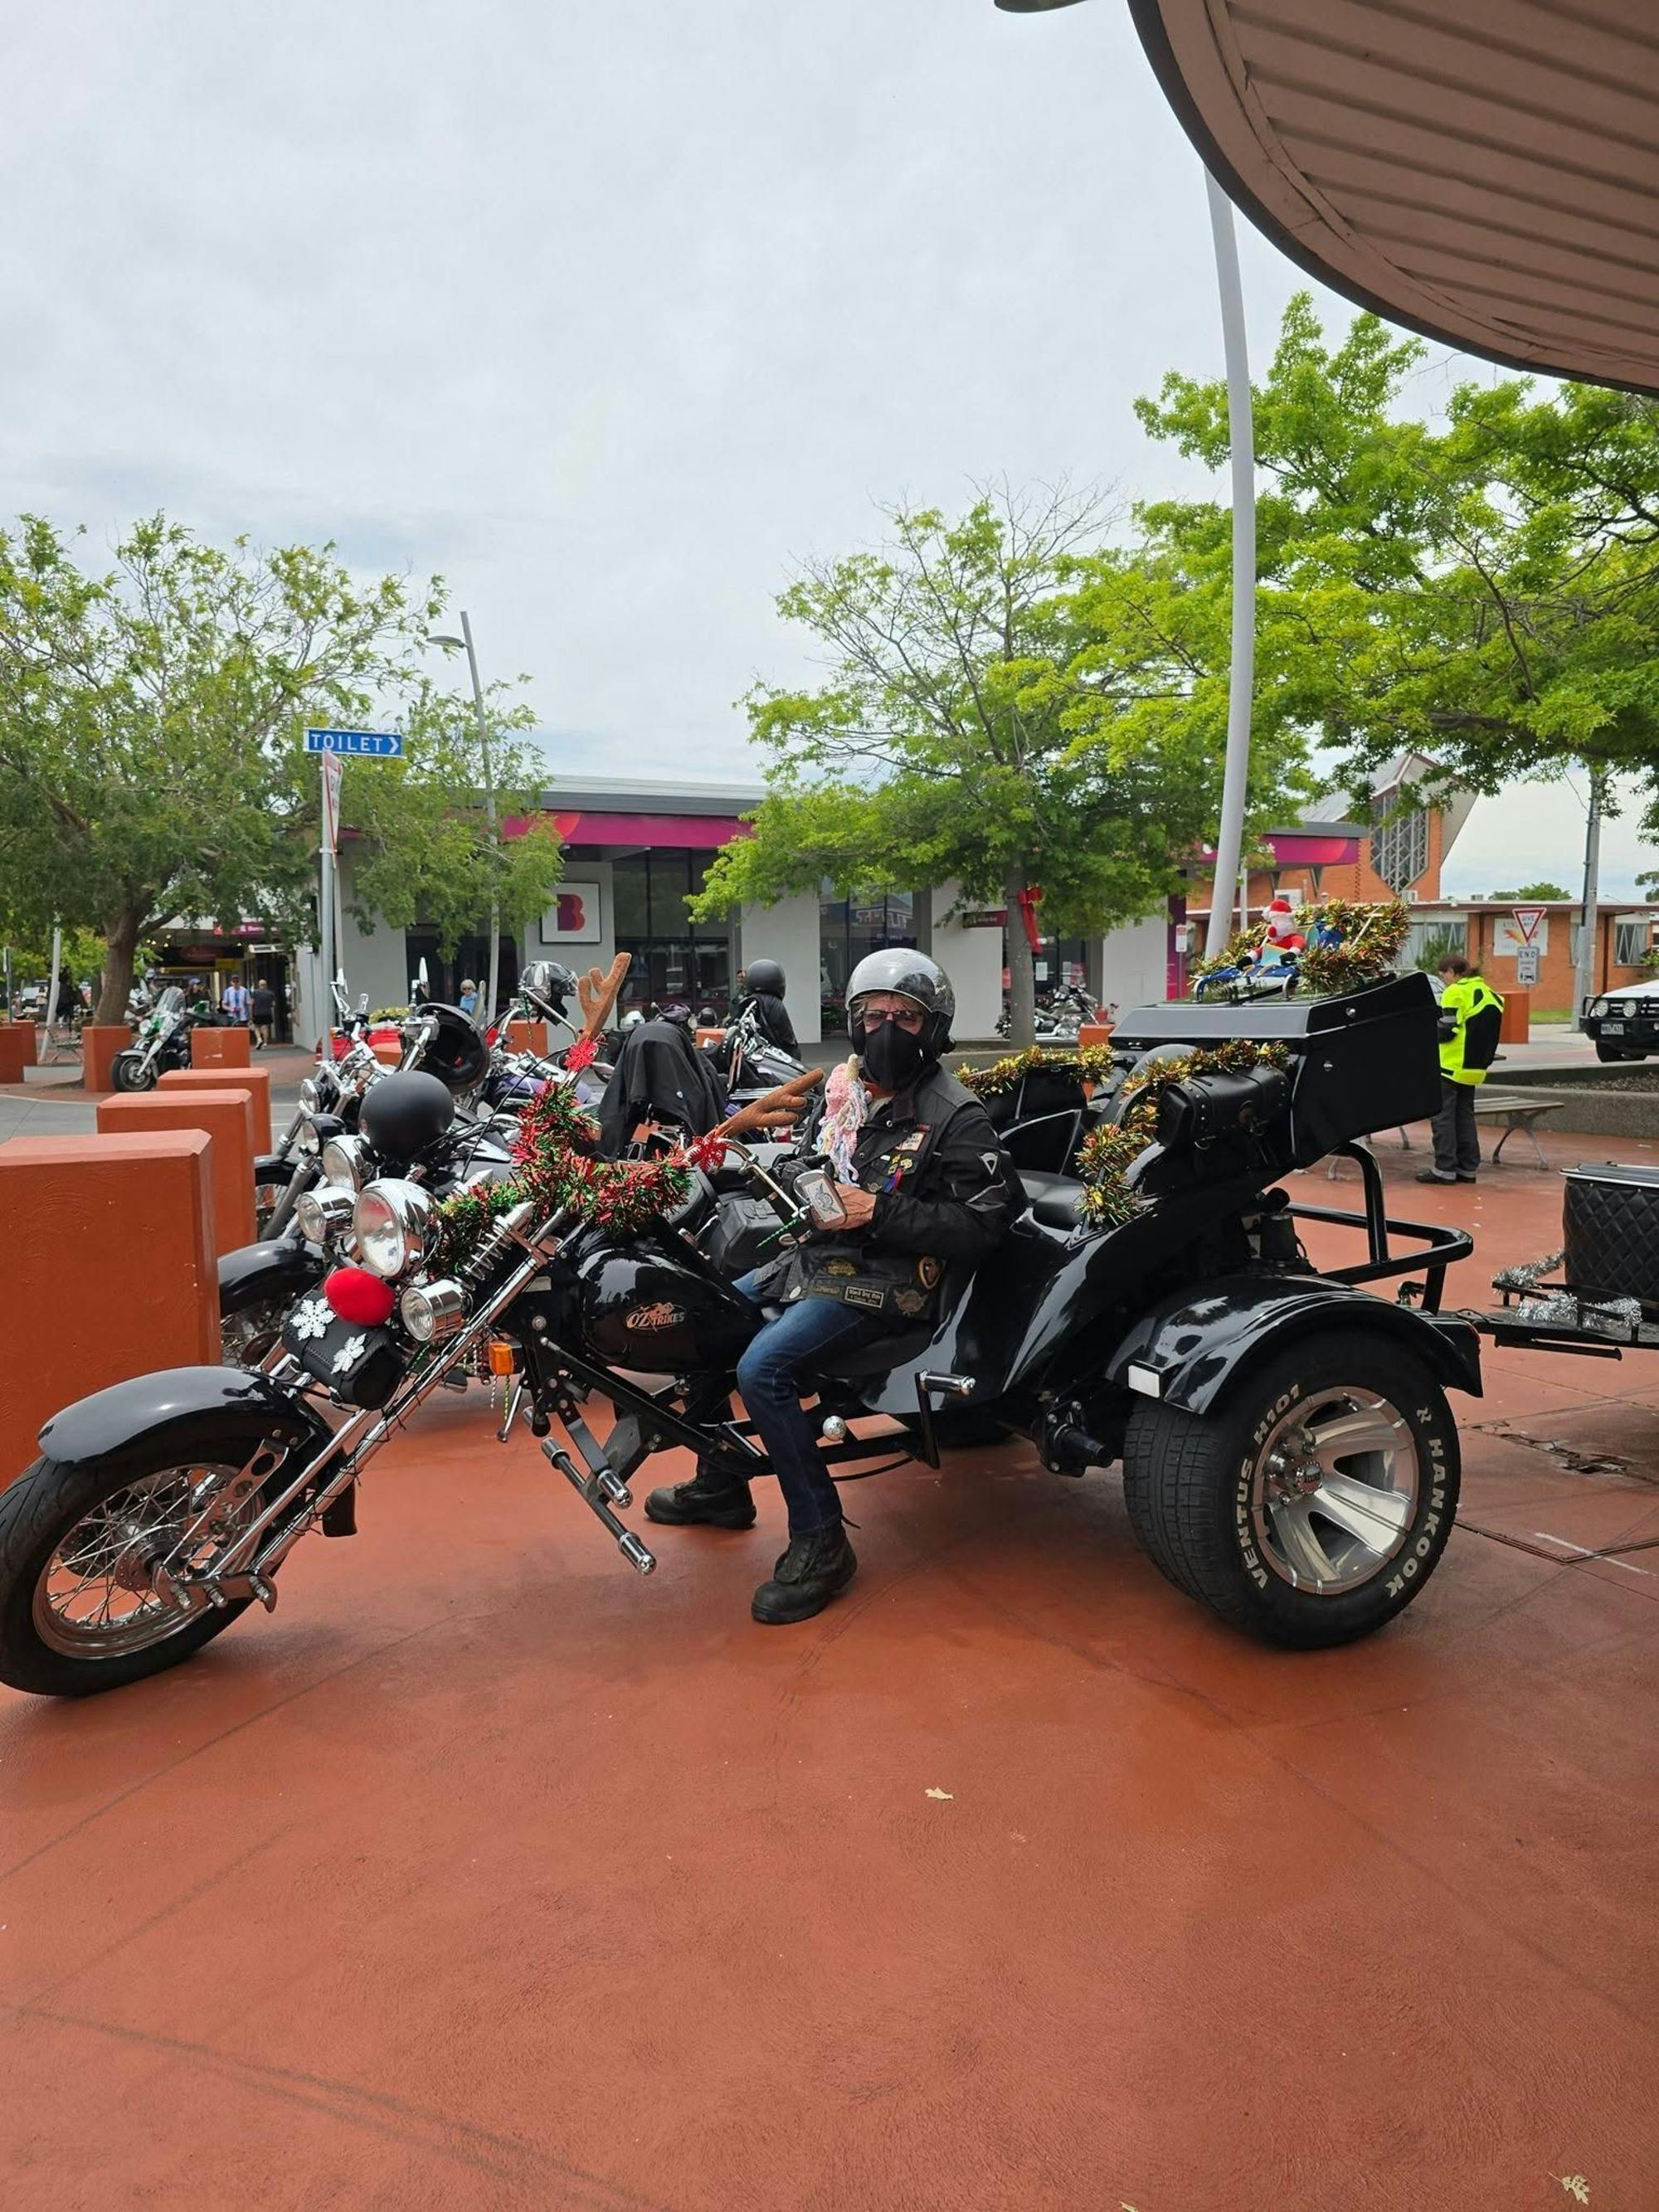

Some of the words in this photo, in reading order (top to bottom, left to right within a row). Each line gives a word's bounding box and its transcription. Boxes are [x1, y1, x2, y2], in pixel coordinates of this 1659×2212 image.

[311, 733, 383, 751] TOILET
[1237, 1458, 1268, 1589] VENTUS
[1253, 1384, 1300, 1446] H101
[1385, 1437, 1446, 1598] HANKOOK
